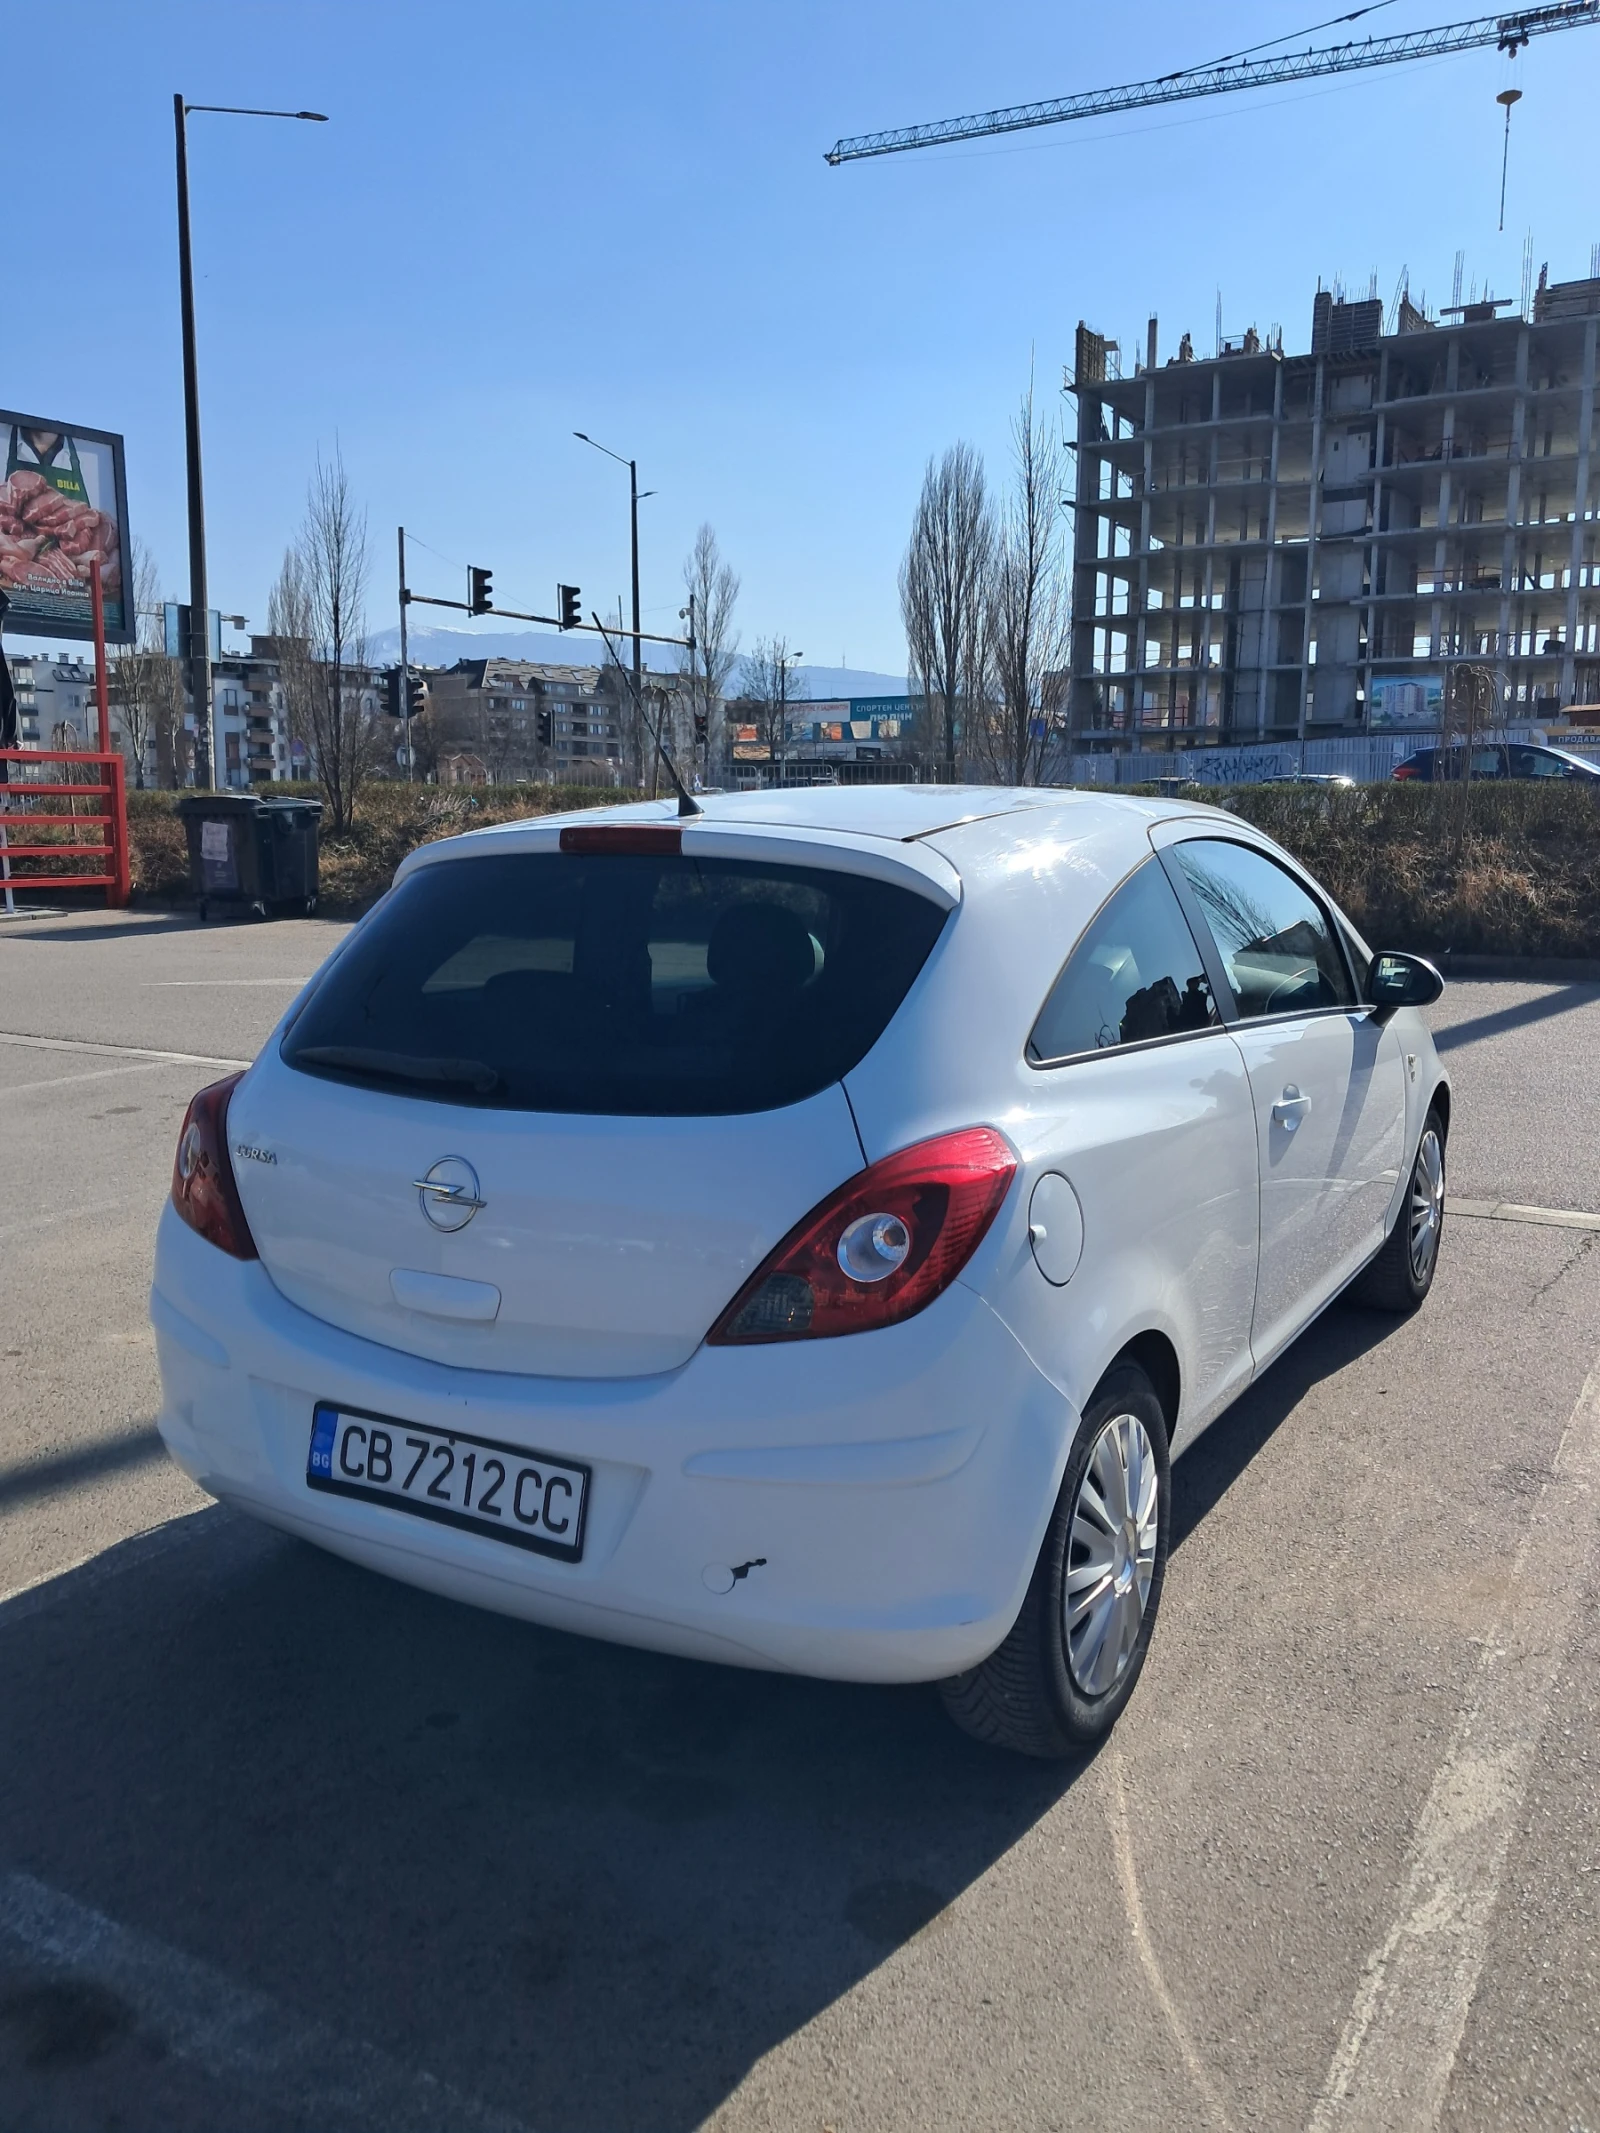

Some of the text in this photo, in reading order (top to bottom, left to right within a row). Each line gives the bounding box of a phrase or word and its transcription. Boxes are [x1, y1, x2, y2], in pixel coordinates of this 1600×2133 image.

[57, 479, 80, 491] BILLA
[28, 573, 60, 584] Валидно
[30, 584, 60, 594] Царица
[856, 704, 892, 713] СПОРТЕН
[235, 1144, 278, 1166] CORSA
[311, 1450, 331, 1470] BG
